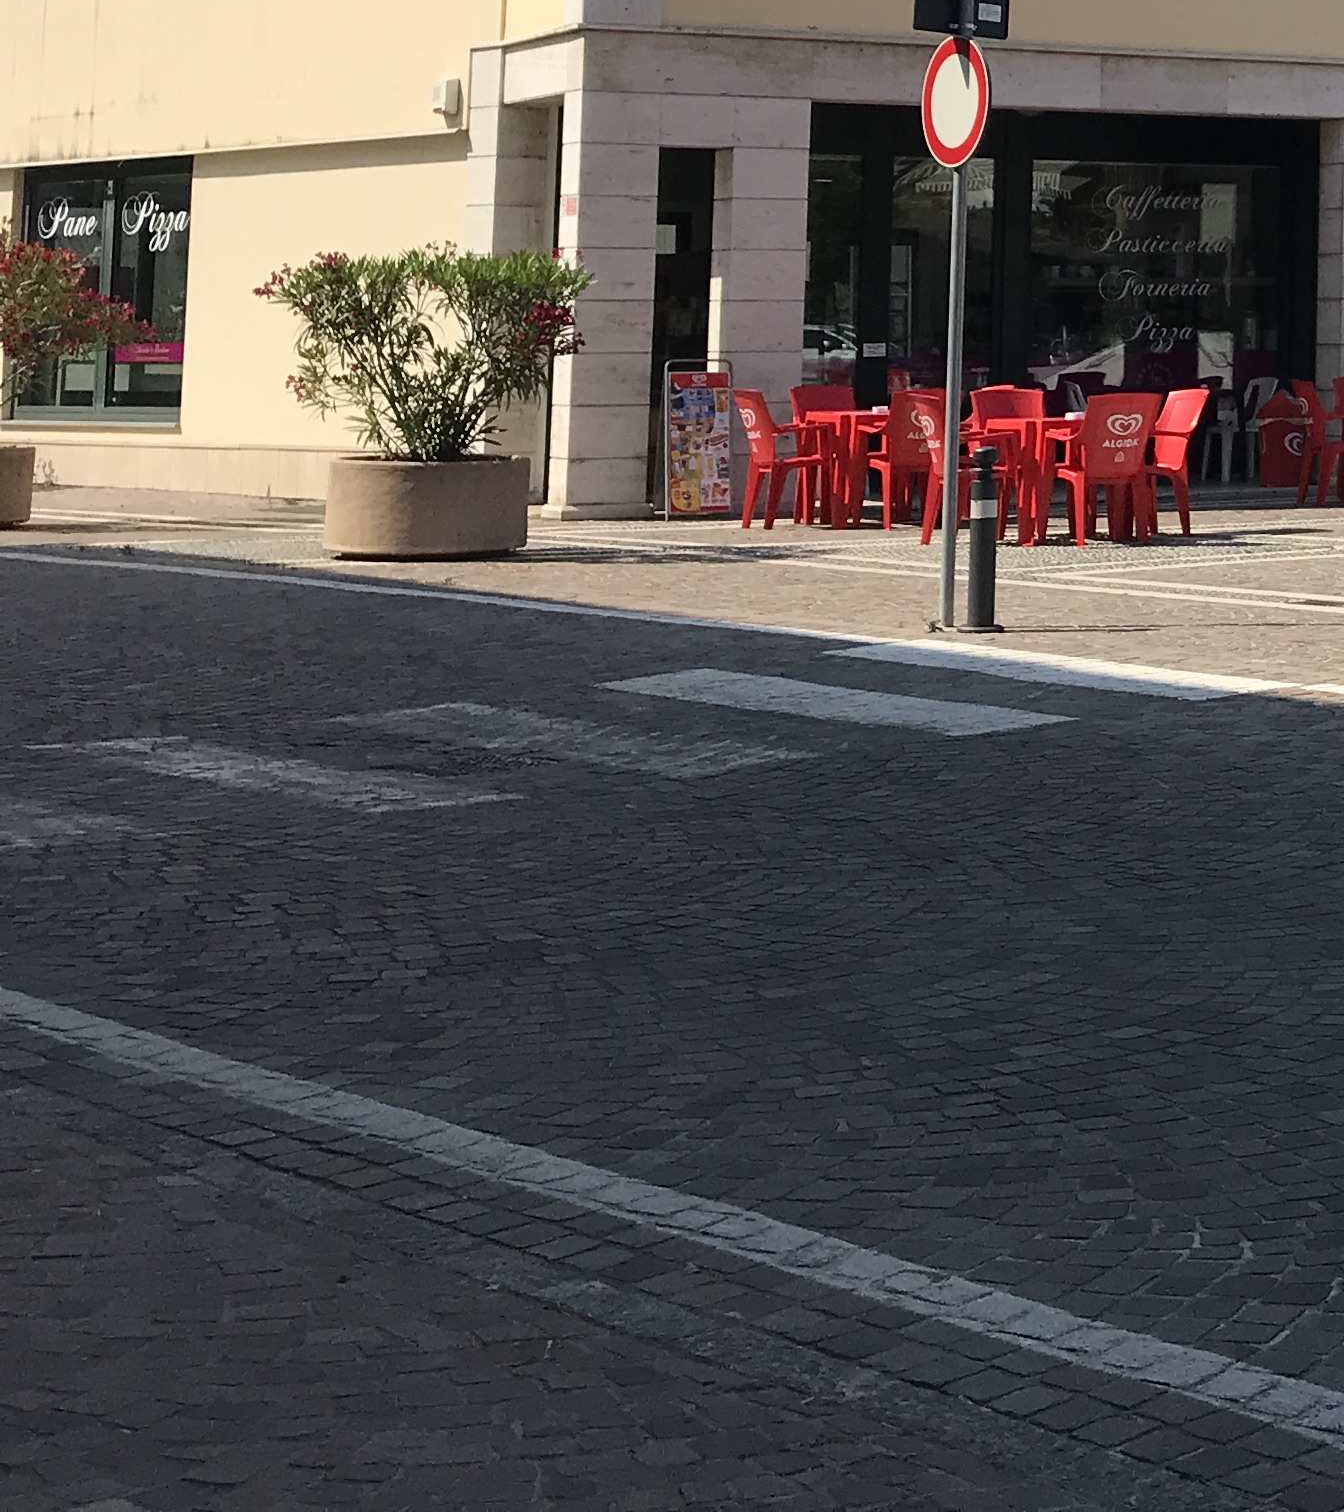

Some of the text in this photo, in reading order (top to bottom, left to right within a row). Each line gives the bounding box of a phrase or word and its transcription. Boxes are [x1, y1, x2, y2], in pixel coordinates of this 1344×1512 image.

[1091, 184, 1222, 221] Caffetteria
[37, 190, 190, 252] Pane Pizza
[1084, 225, 1231, 253] Pasticceria
[1098, 269, 1212, 302] Forneria
[1116, 311, 1195, 353] Pizza
[1101, 438, 1139, 448] ALGIDA
